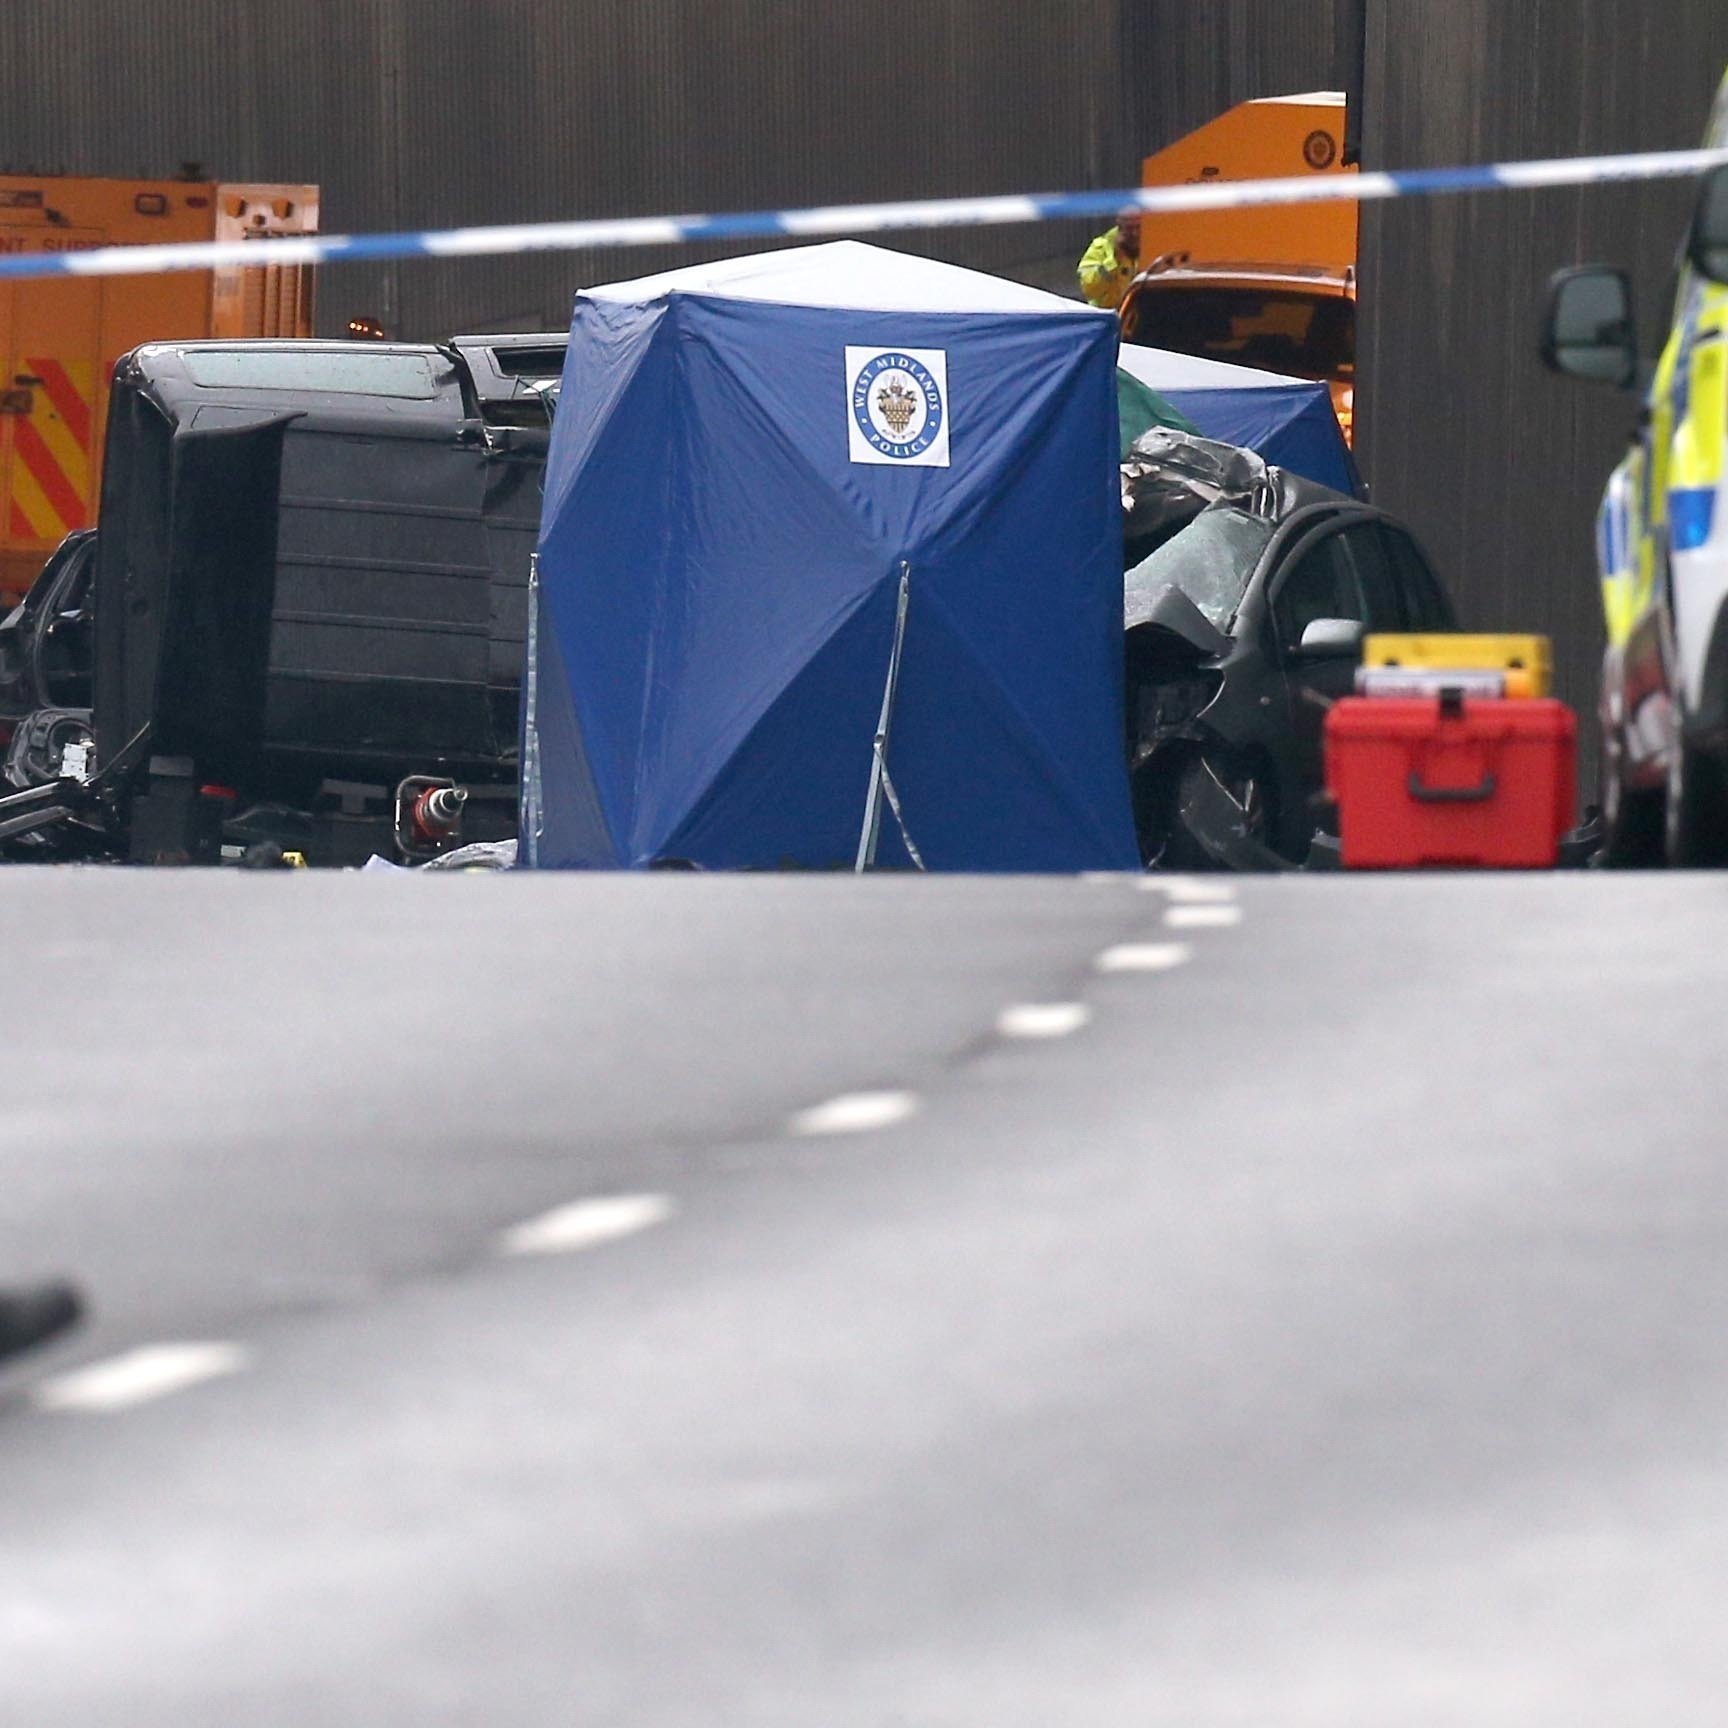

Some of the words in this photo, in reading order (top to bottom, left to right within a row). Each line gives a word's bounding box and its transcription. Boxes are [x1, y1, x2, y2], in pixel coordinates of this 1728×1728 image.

[855, 369, 874, 409] WEST
[875, 355, 941, 412] MIDLANDS
[870, 433, 930, 457] POLICE
